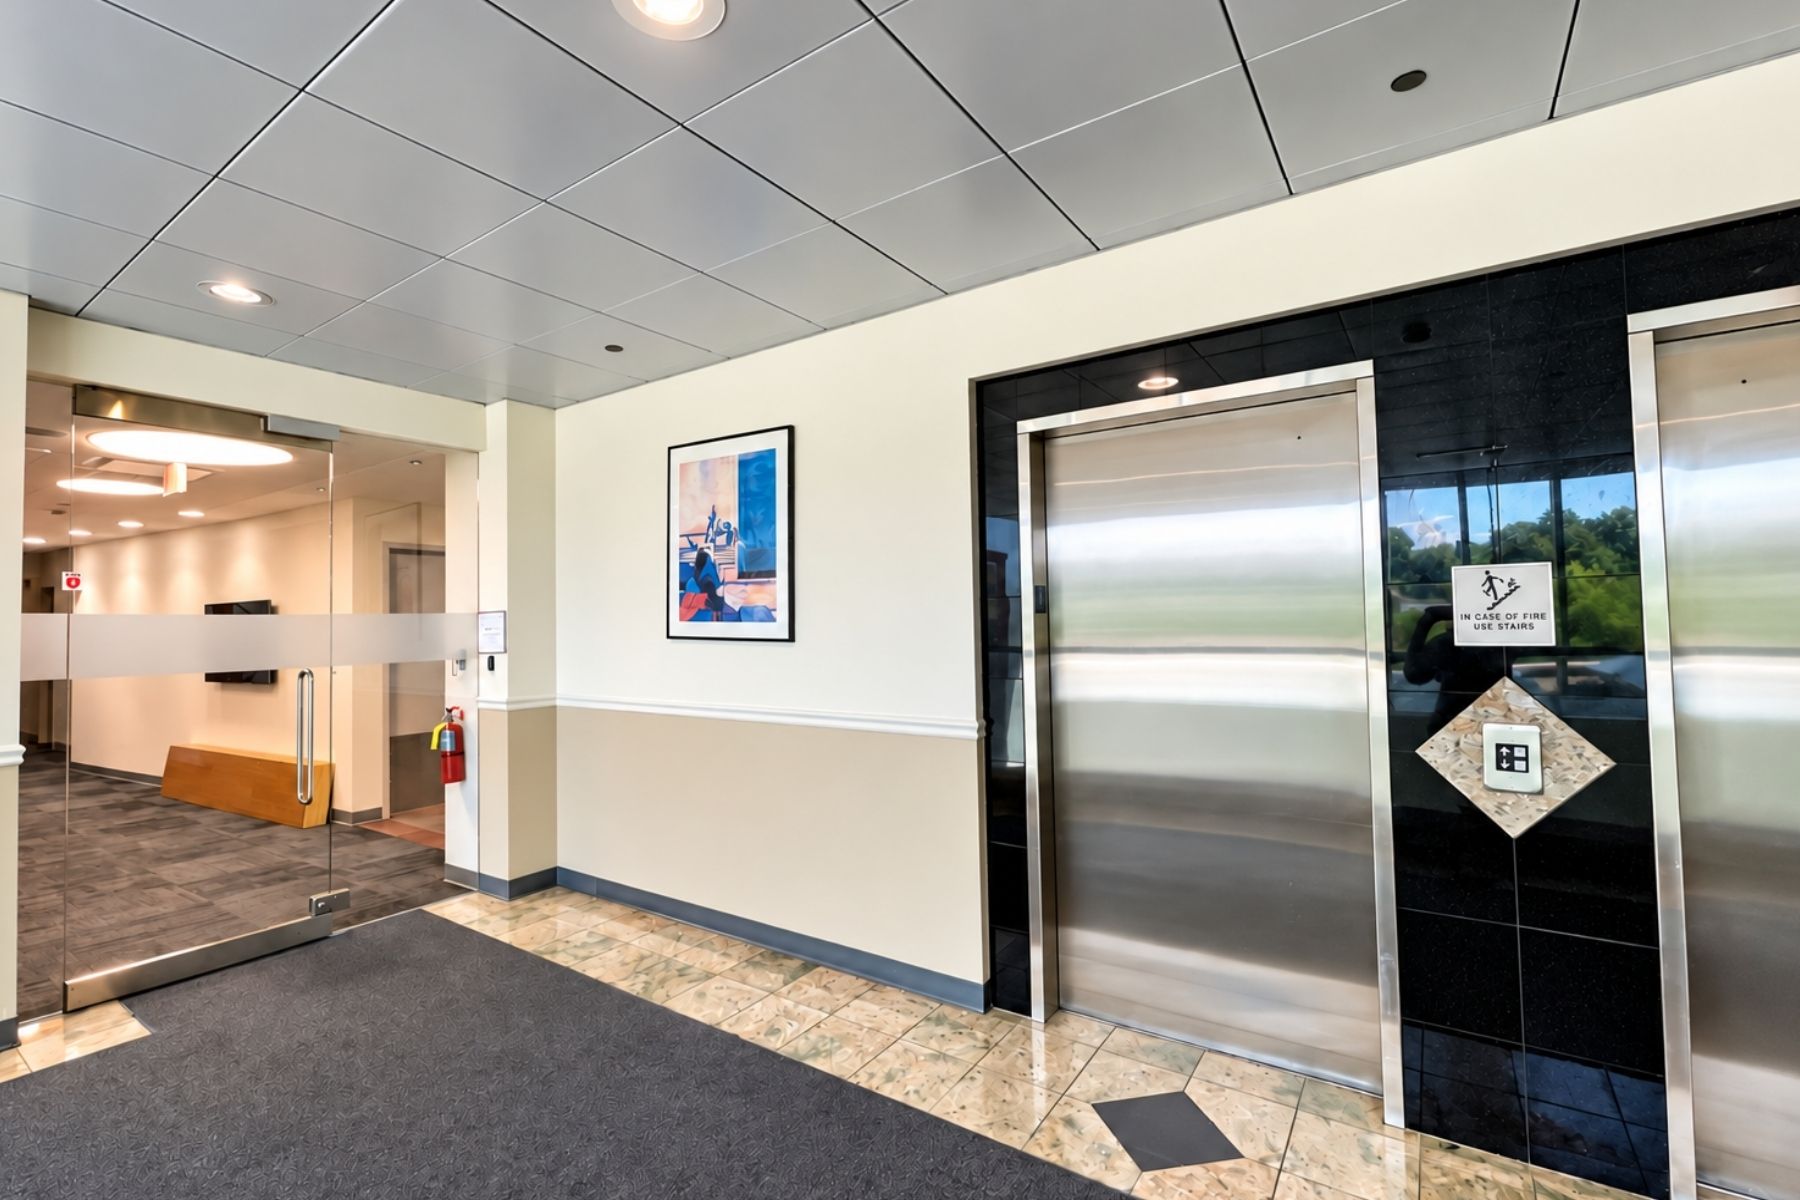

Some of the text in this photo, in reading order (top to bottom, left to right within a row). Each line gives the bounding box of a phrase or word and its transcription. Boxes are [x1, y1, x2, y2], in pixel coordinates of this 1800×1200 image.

[1460, 612, 1547, 621] IN CASE OF FIRE
[1497, 622, 1535, 630] STAIRS
